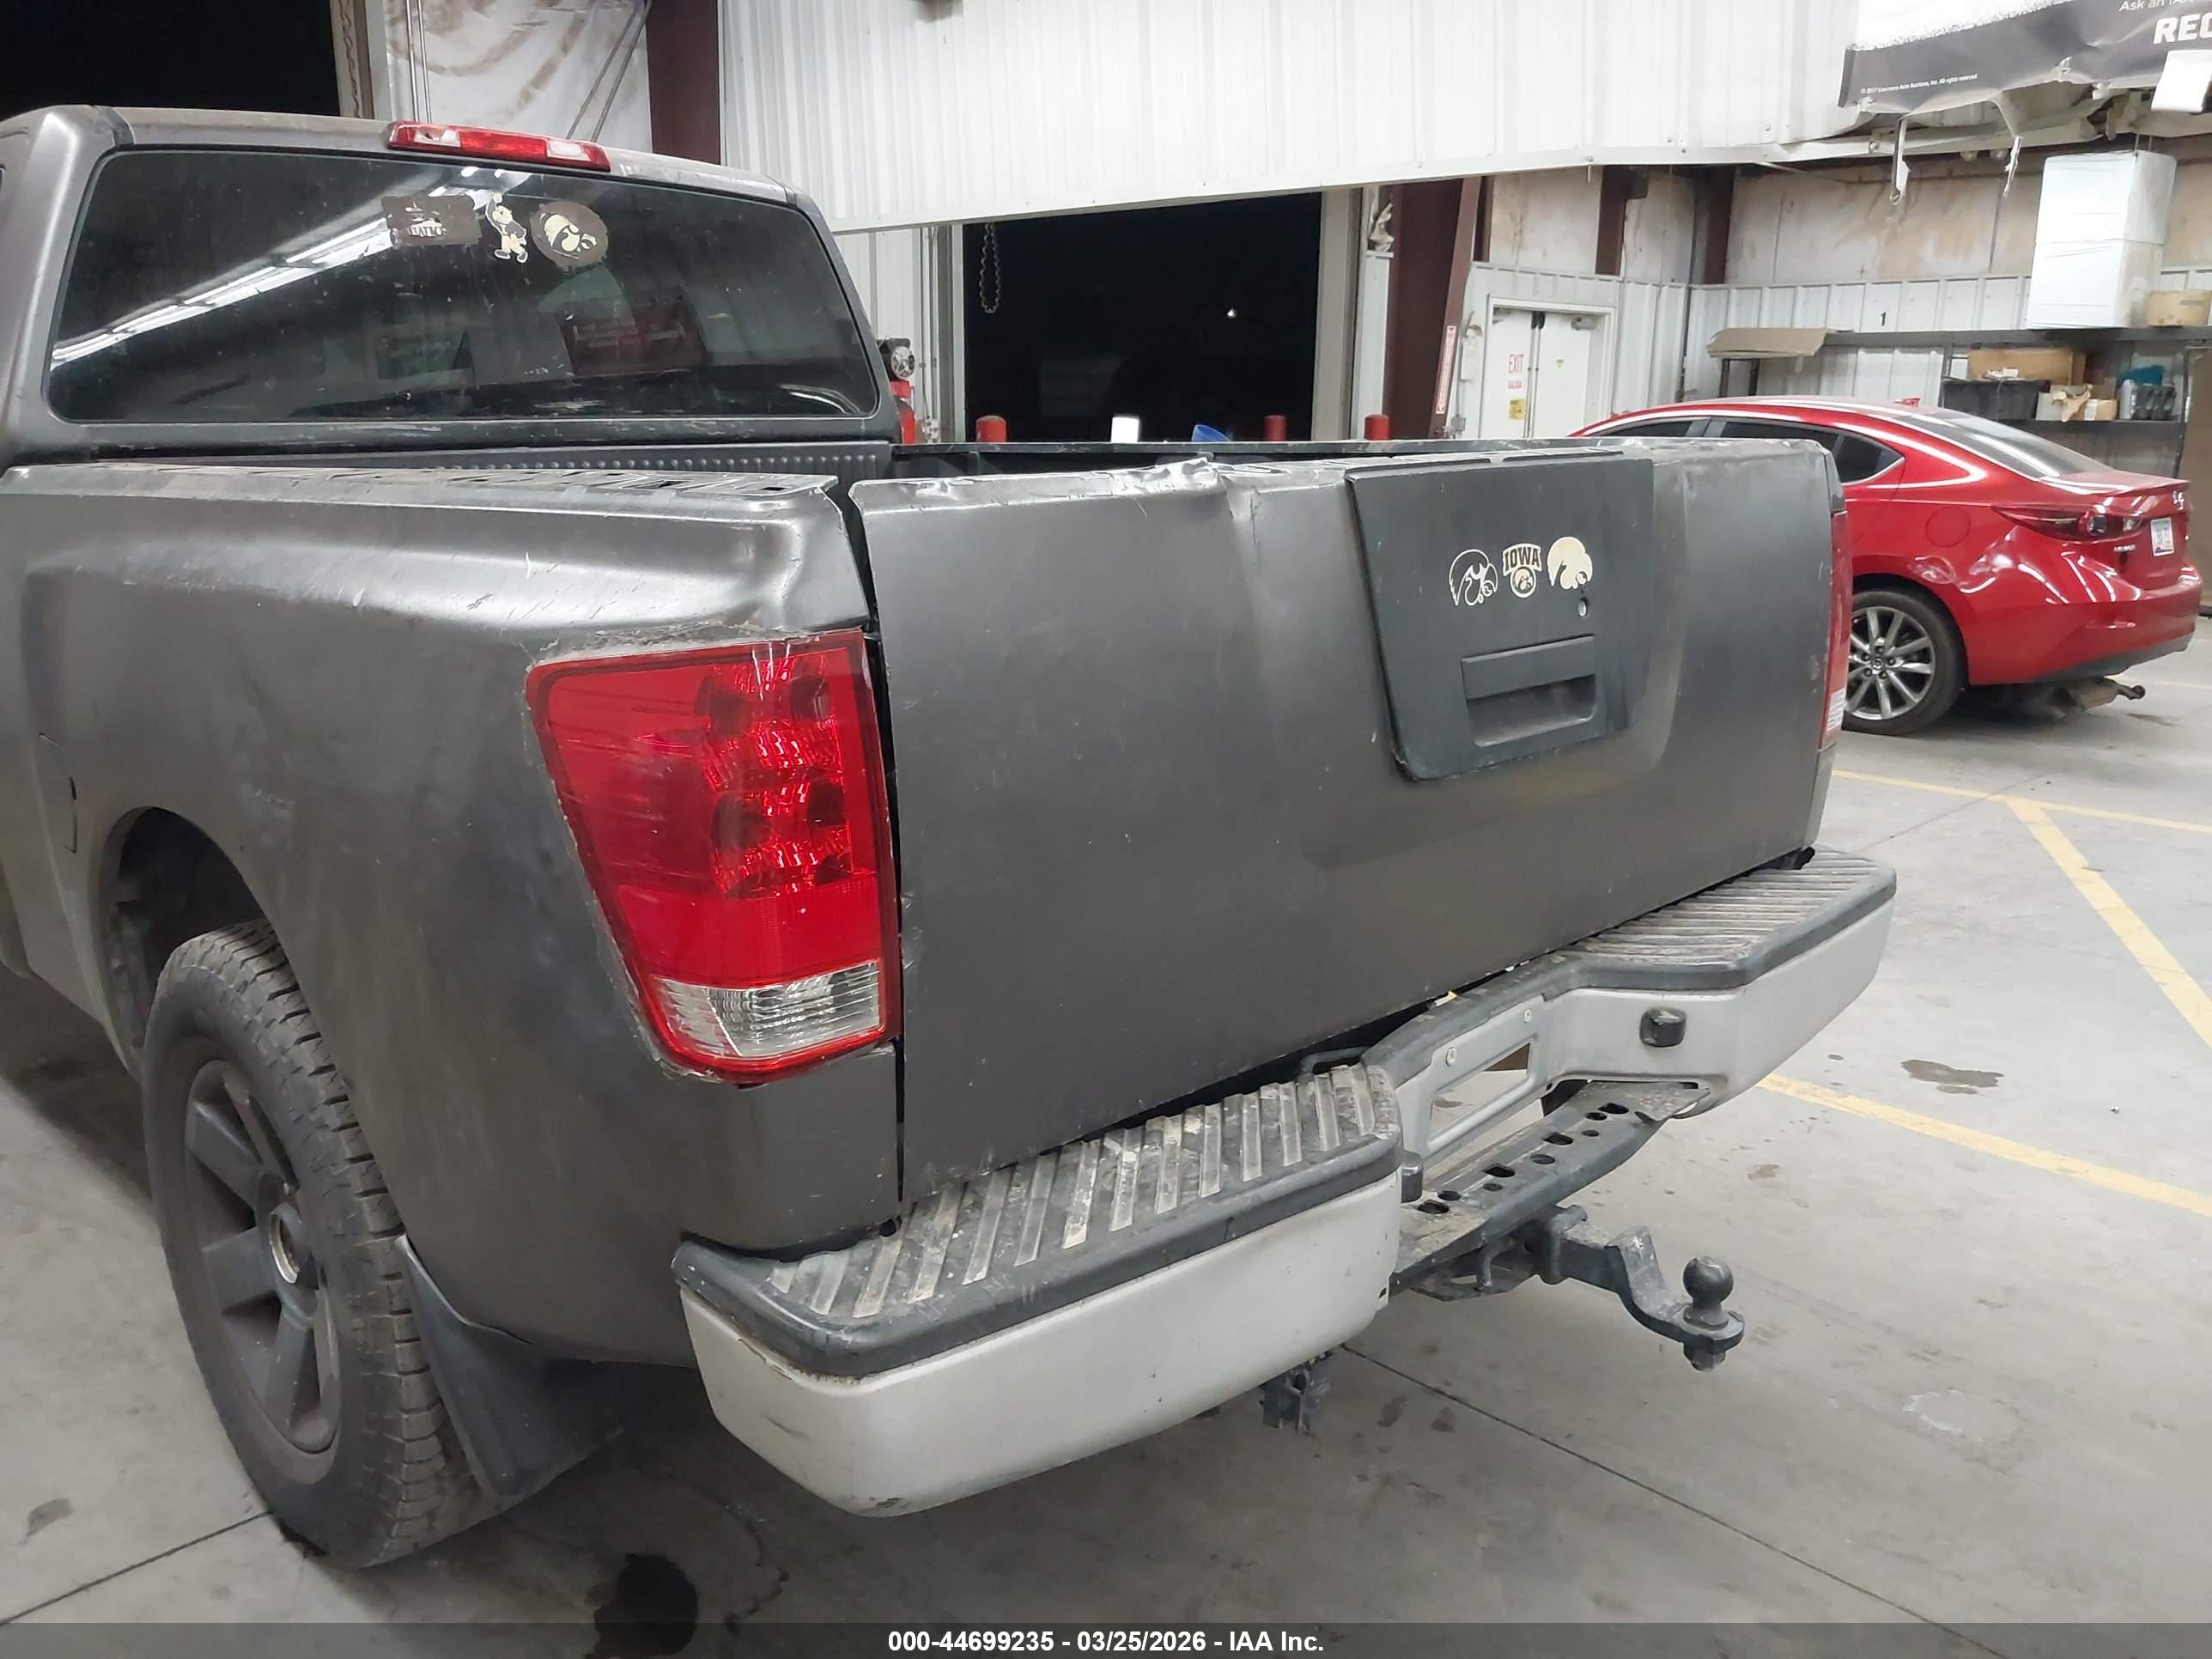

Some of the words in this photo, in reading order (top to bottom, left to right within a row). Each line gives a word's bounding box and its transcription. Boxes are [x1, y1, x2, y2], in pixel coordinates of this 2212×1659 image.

[2118, 0, 2144, 12] Ask
[1509, 354, 1524, 373] EXIT
[1504, 546, 1540, 571] IOWA
